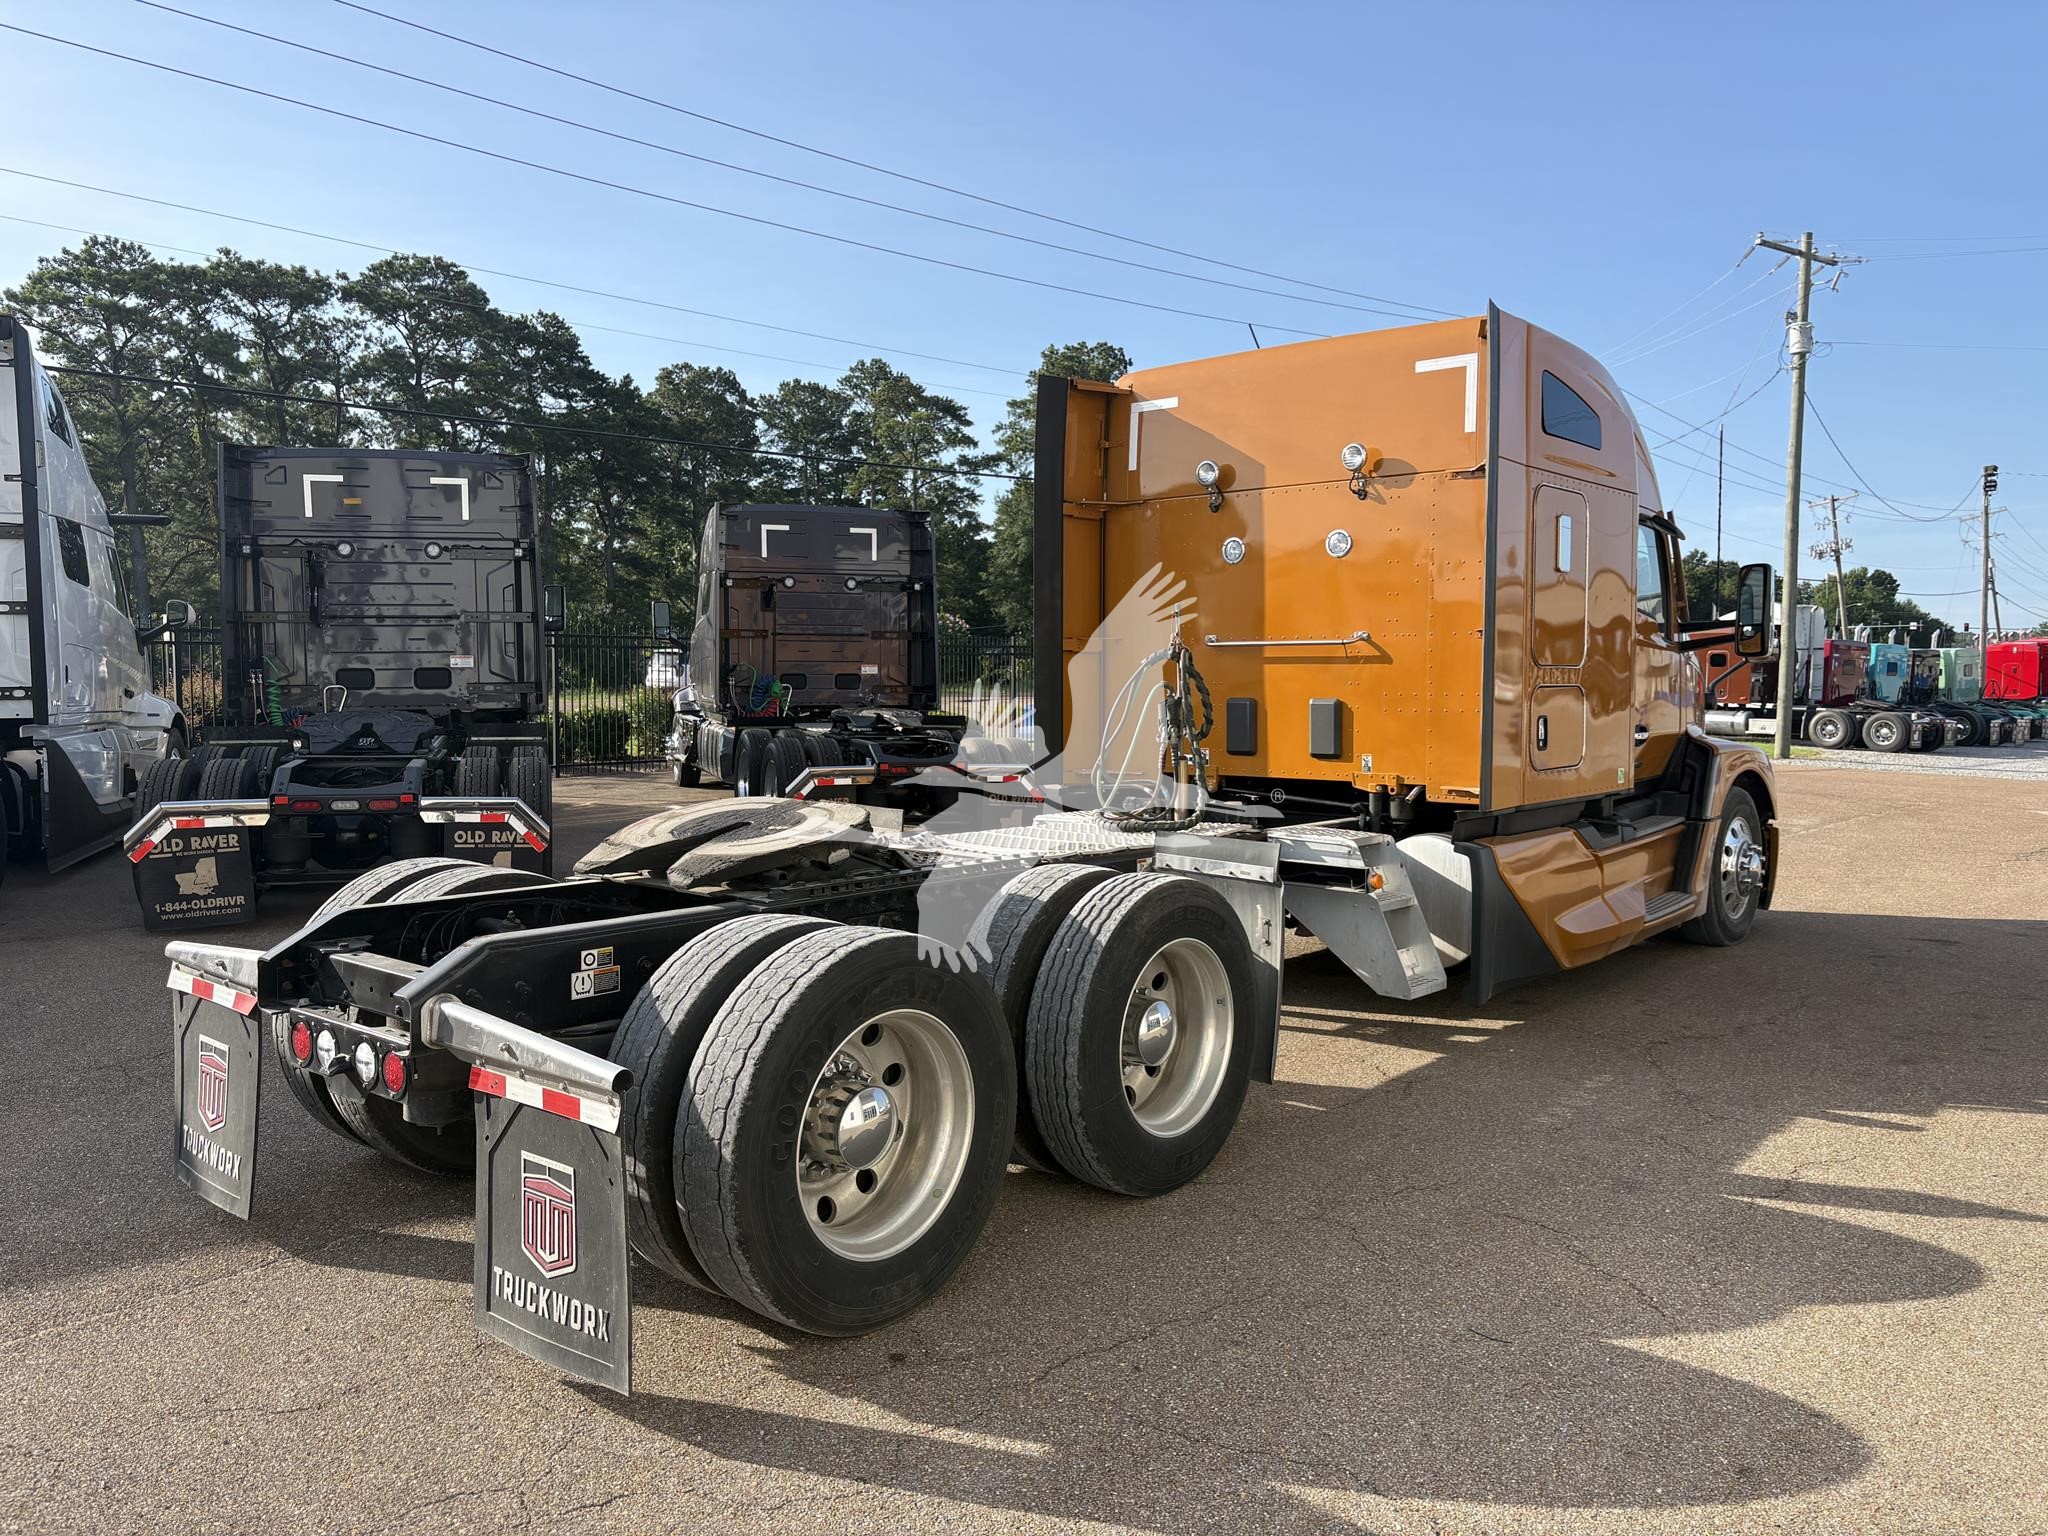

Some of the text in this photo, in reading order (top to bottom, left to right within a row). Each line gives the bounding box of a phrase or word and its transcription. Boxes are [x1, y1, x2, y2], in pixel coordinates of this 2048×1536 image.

[454, 830, 486, 843] OLD
[154, 895, 246, 913] 1-844-OLDRIVR
[160, 907, 241, 921] www.oldriver.com
[183, 1124, 241, 1181] TRUCKWORX
[493, 1265, 611, 1343] TRUCKWORX
